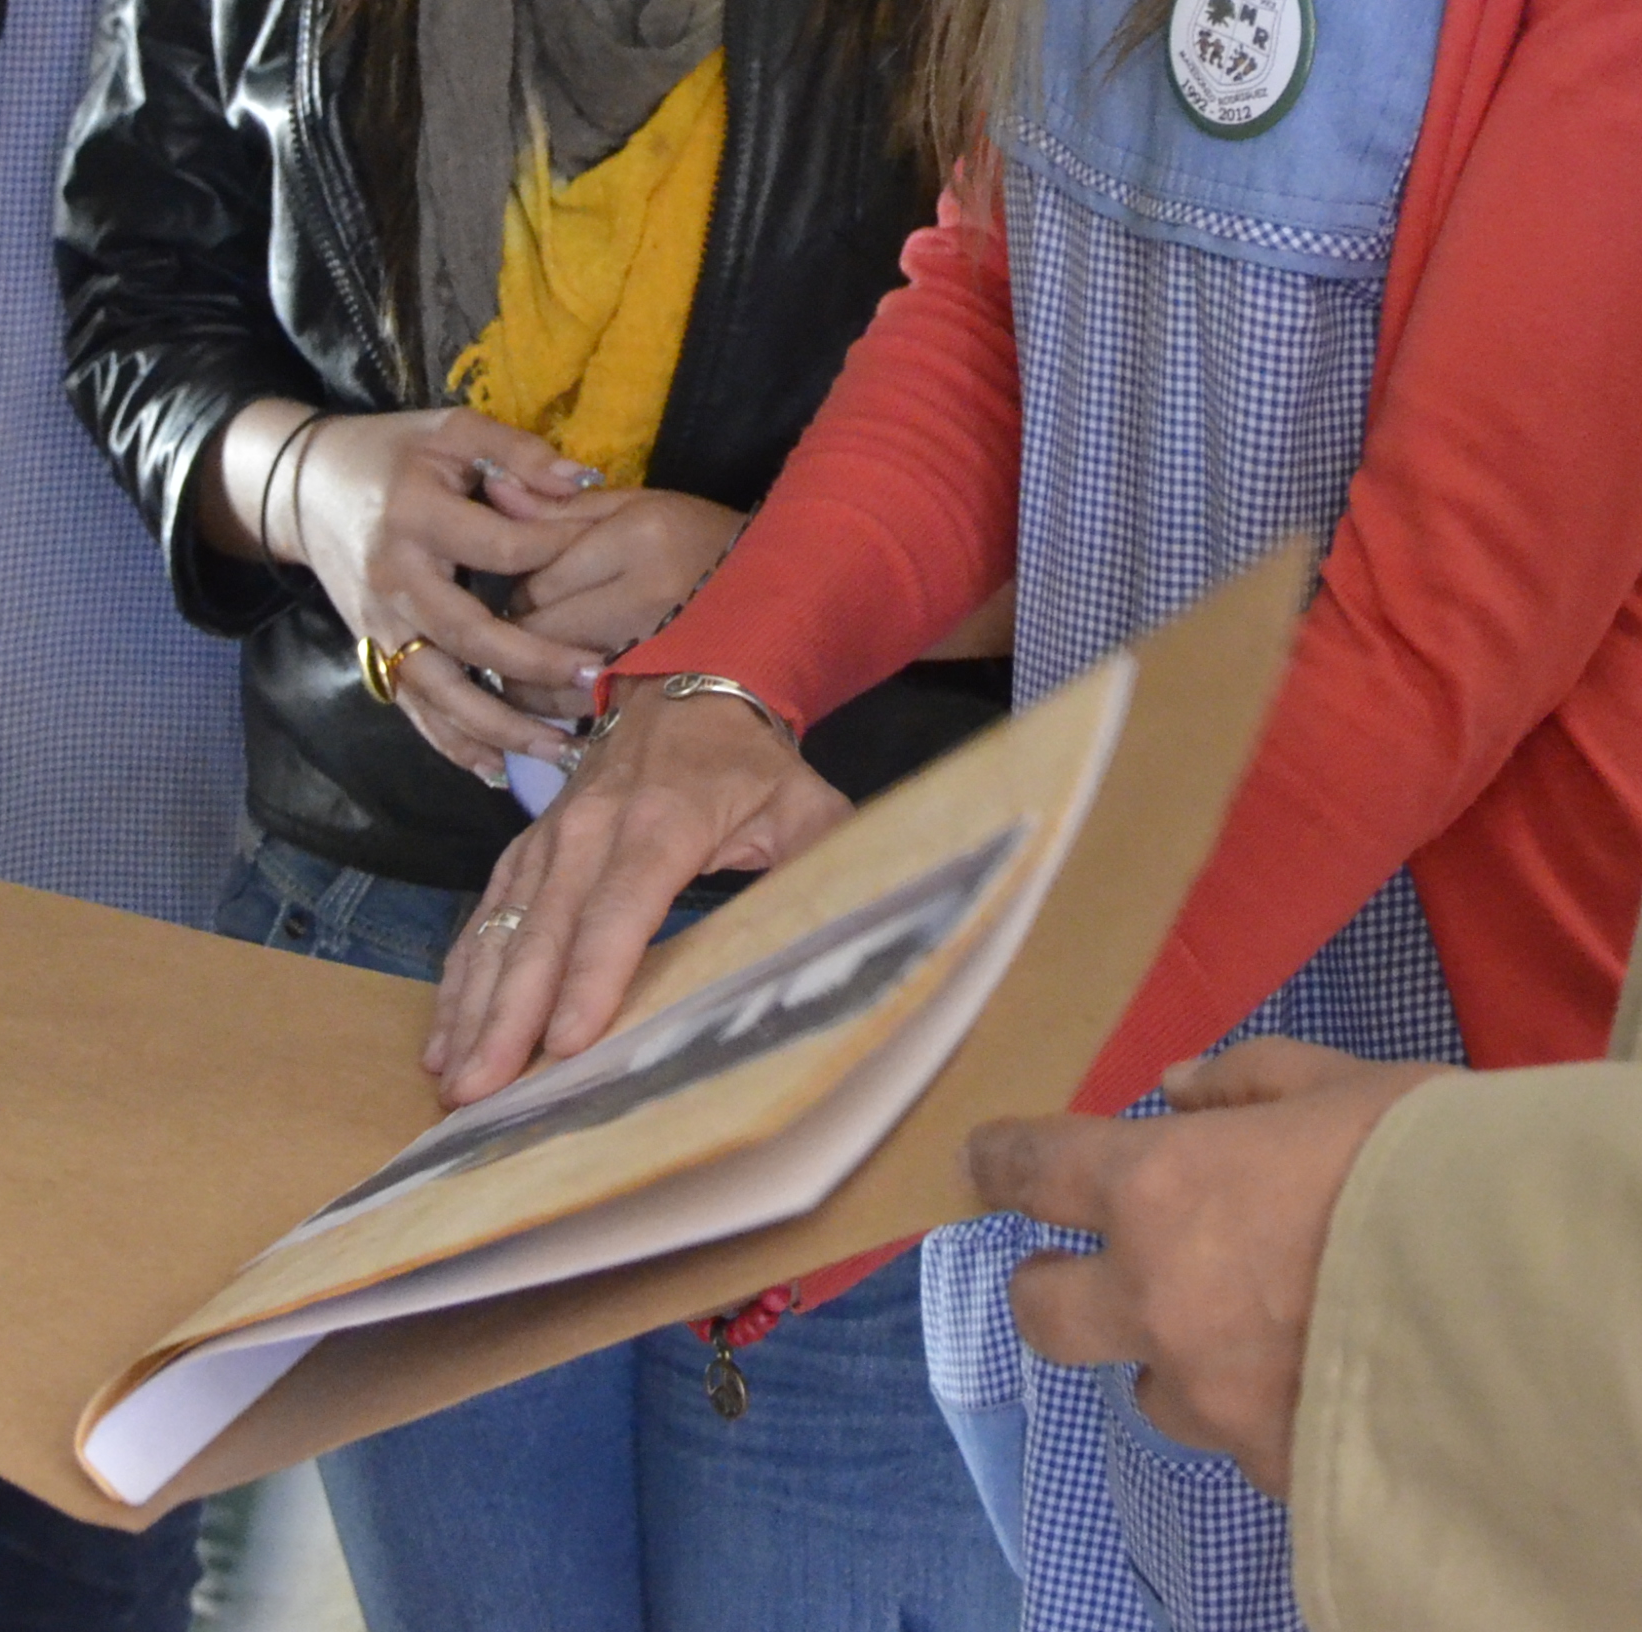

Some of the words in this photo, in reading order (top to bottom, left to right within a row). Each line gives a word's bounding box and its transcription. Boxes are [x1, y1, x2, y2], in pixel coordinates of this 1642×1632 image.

[1253, 27, 1270, 50] R
[1181, 79, 1208, 112] 1992
[1218, 105, 1252, 122] 2012
